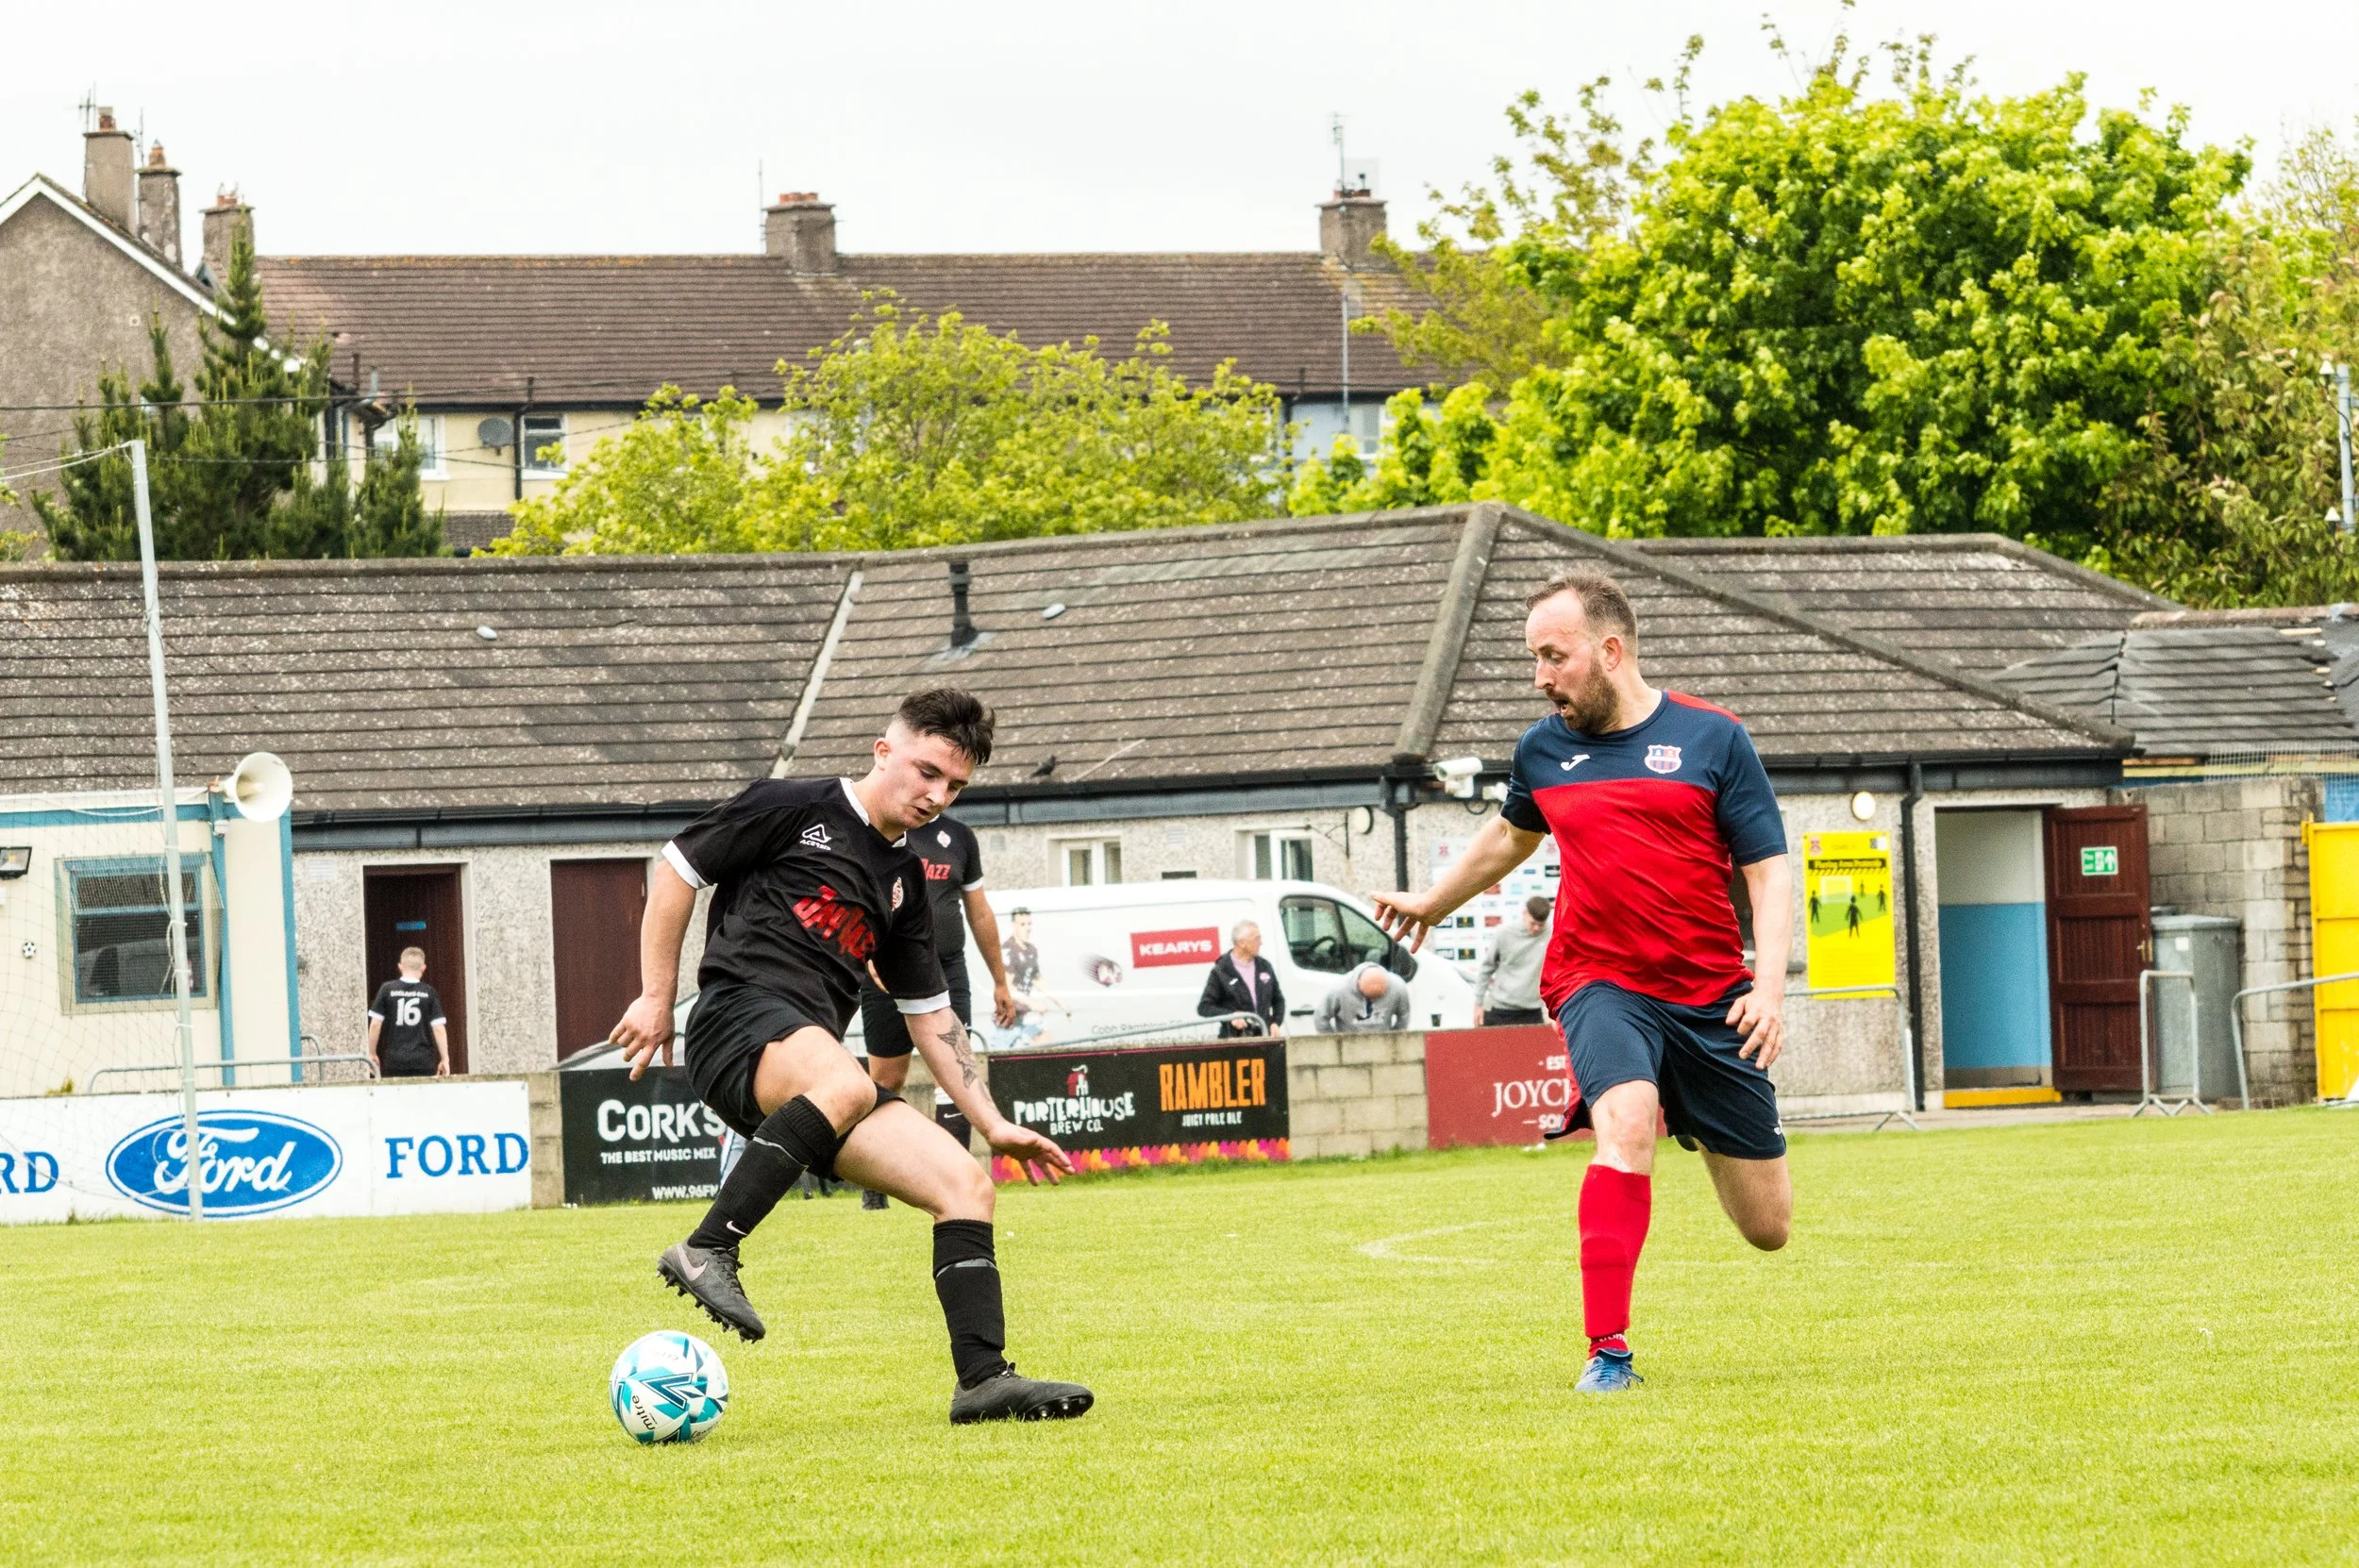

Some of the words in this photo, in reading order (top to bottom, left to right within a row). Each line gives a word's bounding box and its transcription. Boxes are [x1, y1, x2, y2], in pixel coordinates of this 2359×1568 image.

[1139, 940, 1213, 957] KEARYS
[396, 997, 422, 1026] 16
[1159, 1058, 1266, 1112] RAMBLER
[1013, 1092, 1136, 1126] PORTERHOUSE
[1049, 1120, 1083, 1135] BREW
[153, 1126, 297, 1194] Ford
[385, 1132, 529, 1179] FORD
[600, 1151, 624, 1164] THE
[624, 1150, 653, 1163] BEST
[653, 1147, 693, 1161] MUSIC
[693, 1146, 717, 1159] MIX
[631, 1394, 657, 1430] mitre
